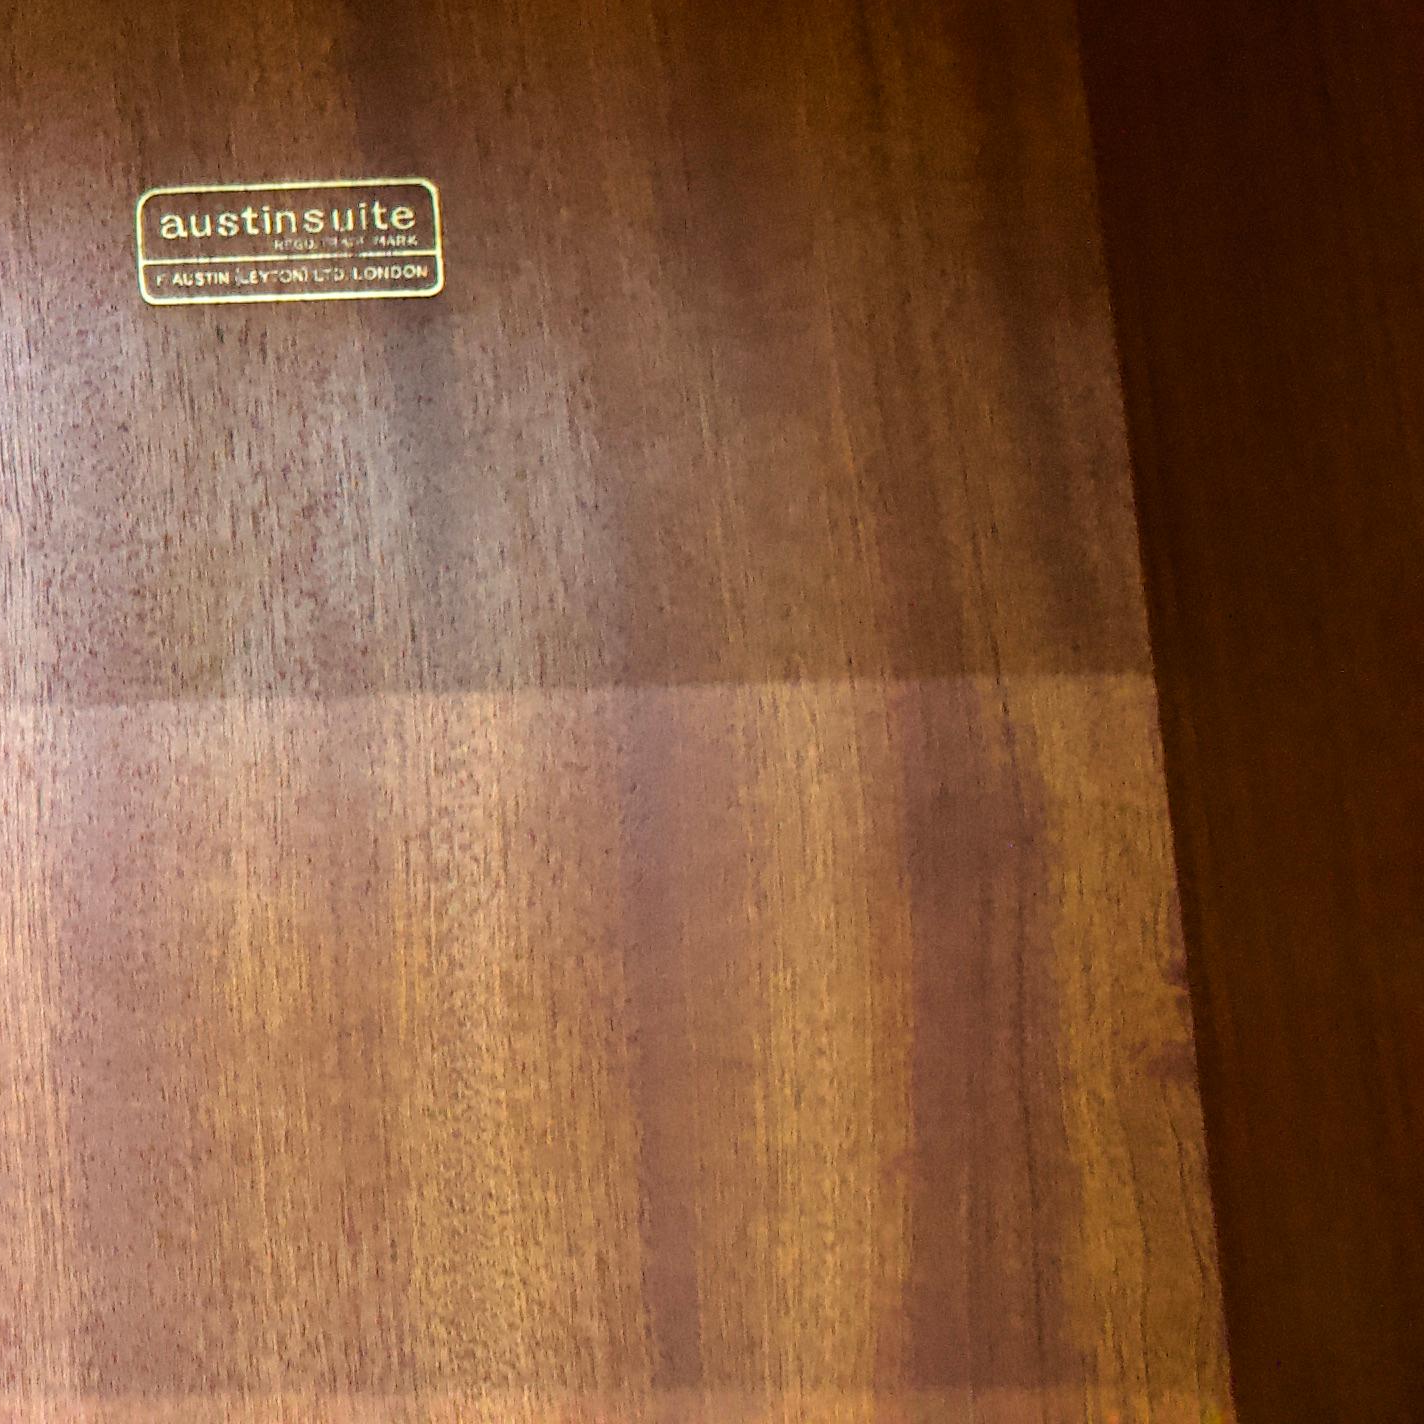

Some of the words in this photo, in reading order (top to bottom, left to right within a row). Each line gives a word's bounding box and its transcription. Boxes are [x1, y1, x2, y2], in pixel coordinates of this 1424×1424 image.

[159, 200, 416, 240] austinsuite
[373, 234, 418, 248] MARK
[172, 271, 230, 287] AUSTIN
[352, 263, 428, 281] LONDON
